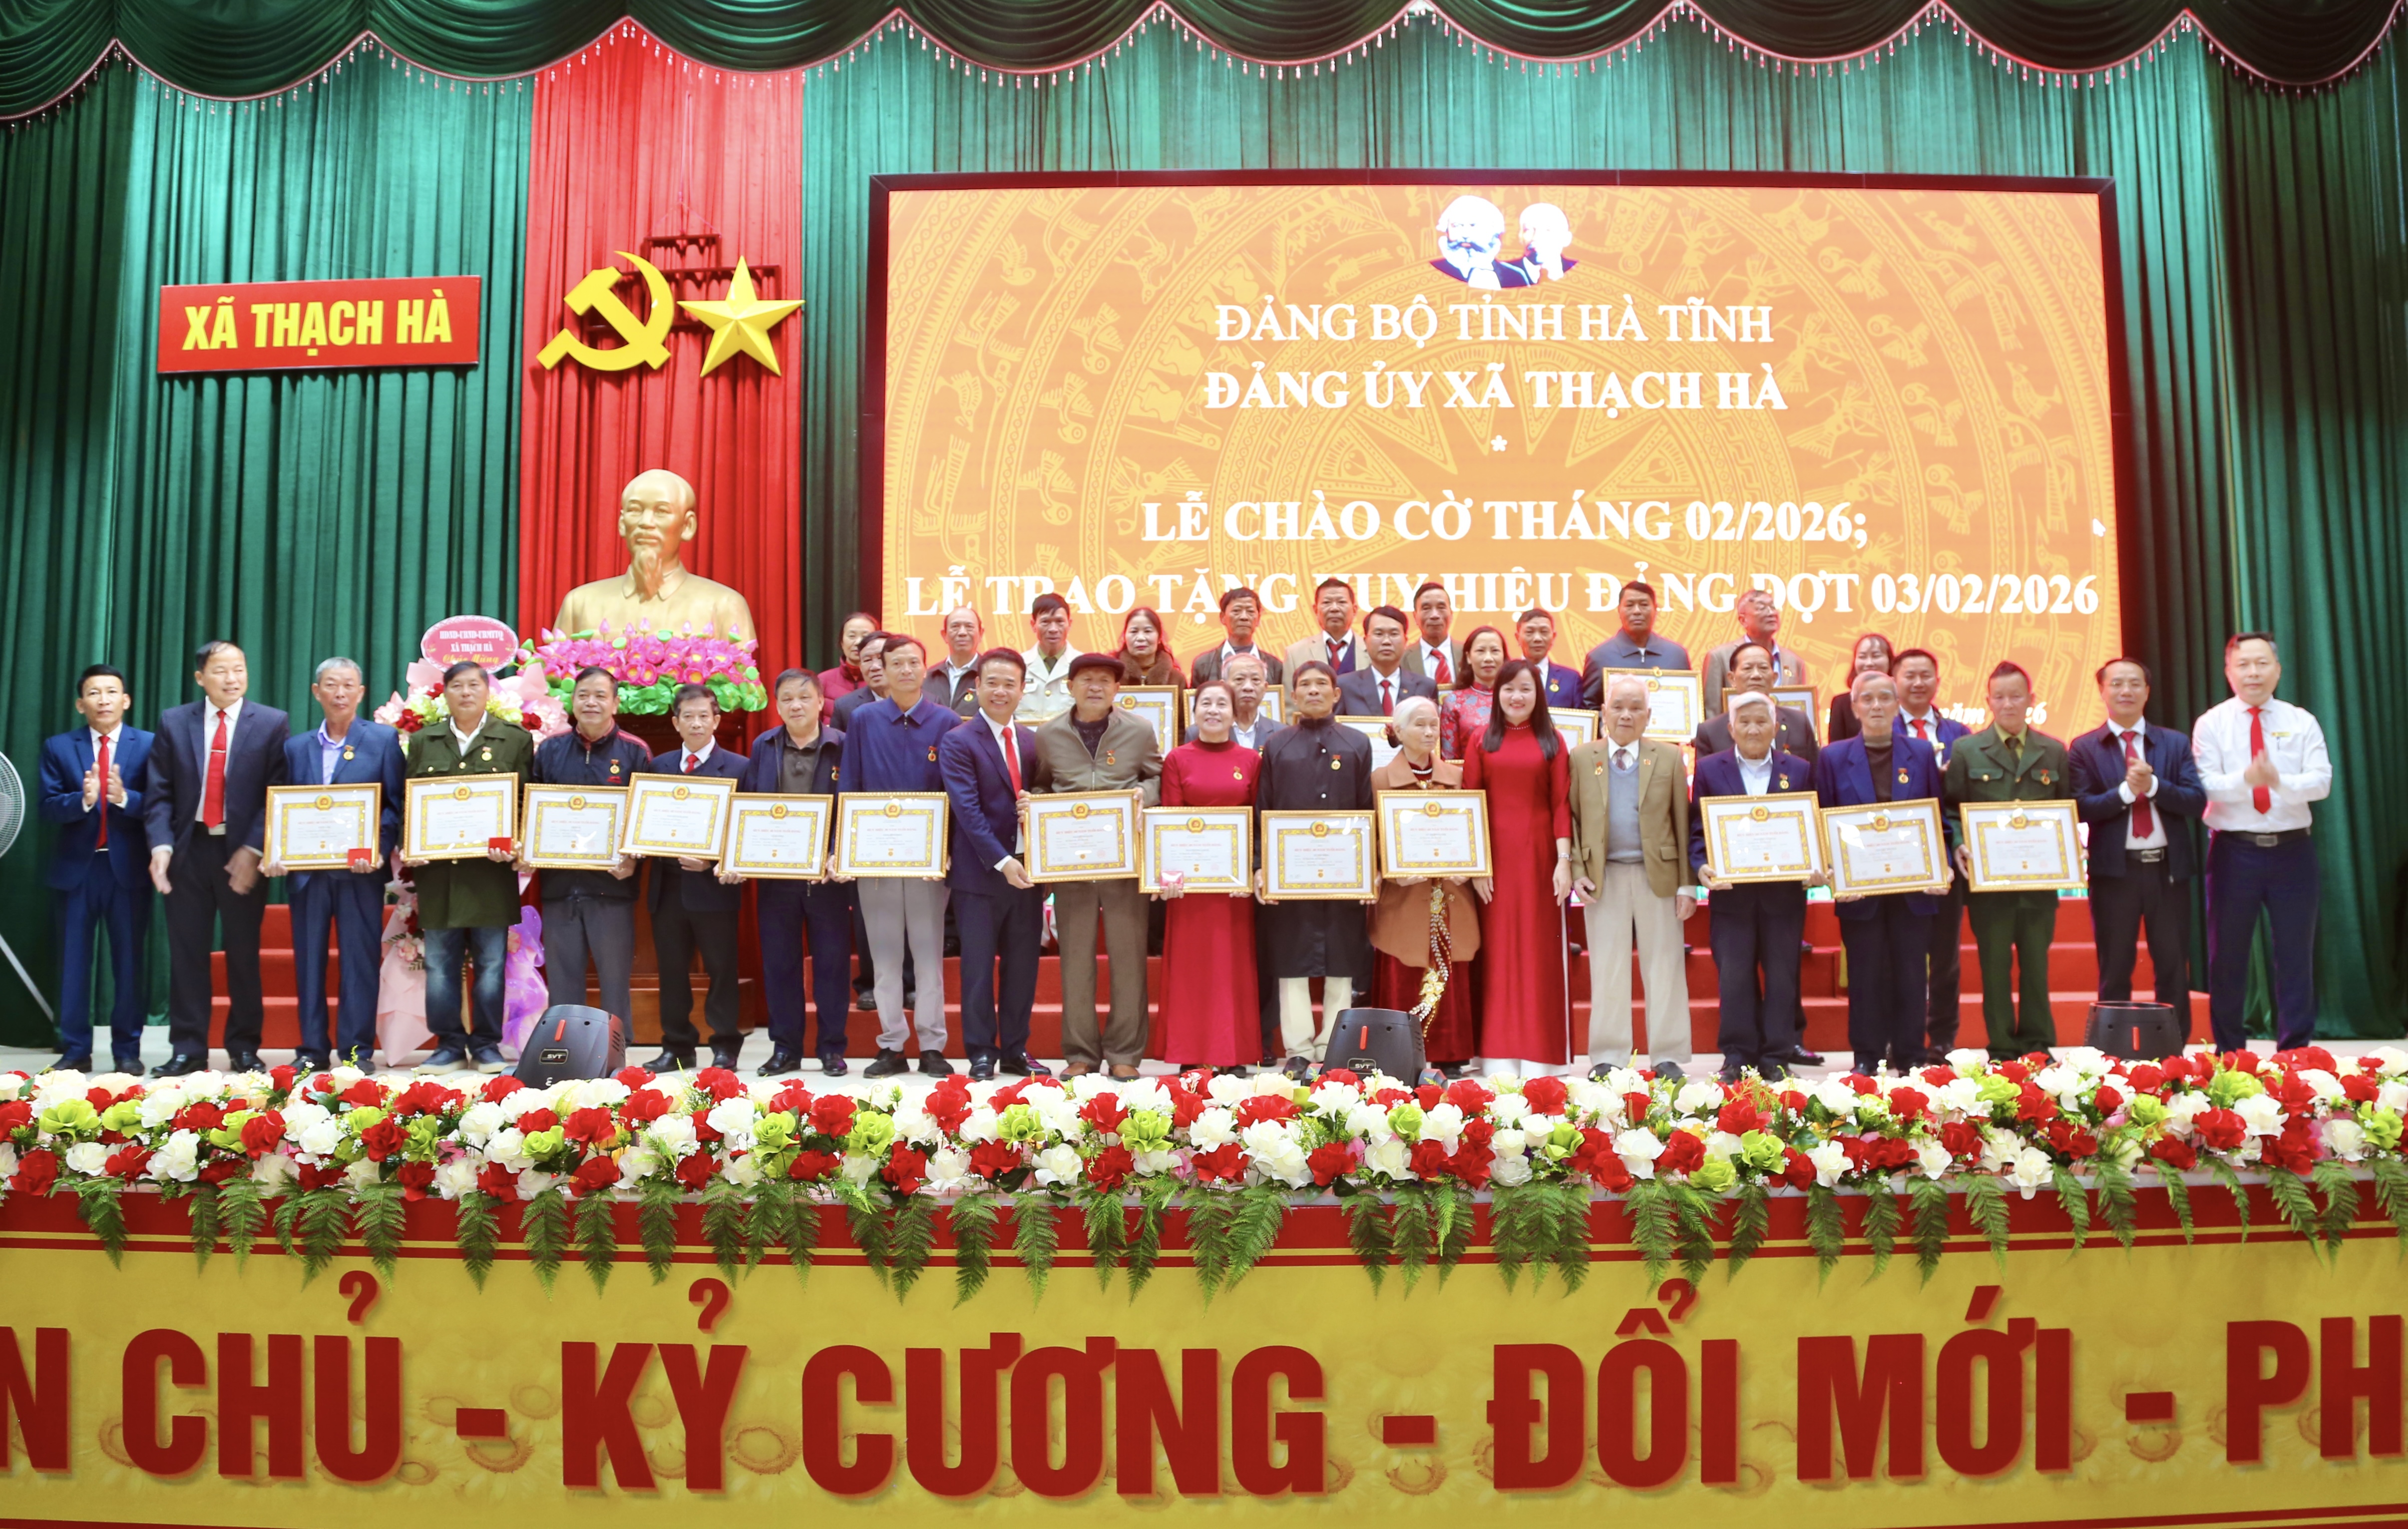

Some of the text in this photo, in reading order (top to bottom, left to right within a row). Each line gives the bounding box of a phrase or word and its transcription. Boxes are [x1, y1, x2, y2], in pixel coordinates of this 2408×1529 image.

[182, 289, 452, 357] XÃ THẠCH HÀ
[1214, 294, 1774, 349] ĐẢNG BỘ TỈNH HÀ TĨNH
[1204, 360, 1788, 418] ĐẢNG ỦY XÃ THẠCH HÀ
[1142, 489, 1868, 549] LỄ CHÀO CỜ THÁNG 02/2026;
[904, 565, 972, 615] LỄ
[1312, 573, 1430, 612] UY
[1440, 566, 1572, 622] HIỆU
[1585, 561, 1737, 613] ĐNG
[1871, 573, 2099, 614] 03/02/2026
[122, 1270, 402, 1483] CHỦ
[562, 1278, 748, 1491] KỶ
[802, 1332, 1326, 1498] CƯƠNG
[1487, 1278, 1739, 1490] ĐỔI
[1797, 1285, 2071, 1481] MỚI
[2226, 1315, 2404, 1463] PH
